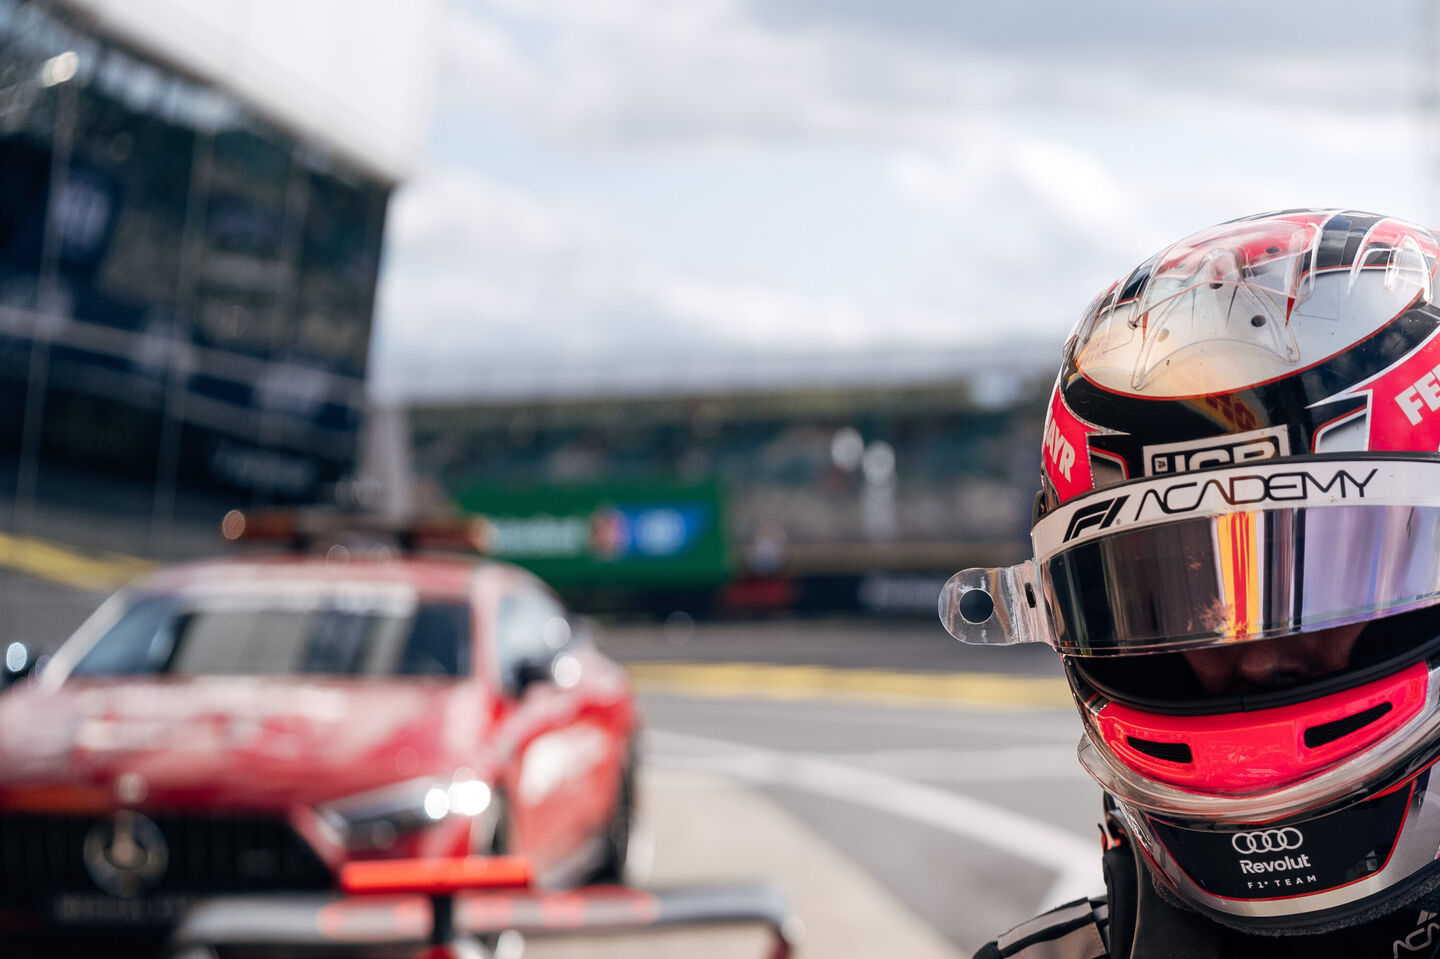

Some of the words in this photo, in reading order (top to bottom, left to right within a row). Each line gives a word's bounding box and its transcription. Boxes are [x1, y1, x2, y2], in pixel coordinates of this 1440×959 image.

[1133, 468, 1379, 522] ACADEMY
[1239, 853, 1312, 875] Revolut
[1274, 874, 1317, 888] TEAM
